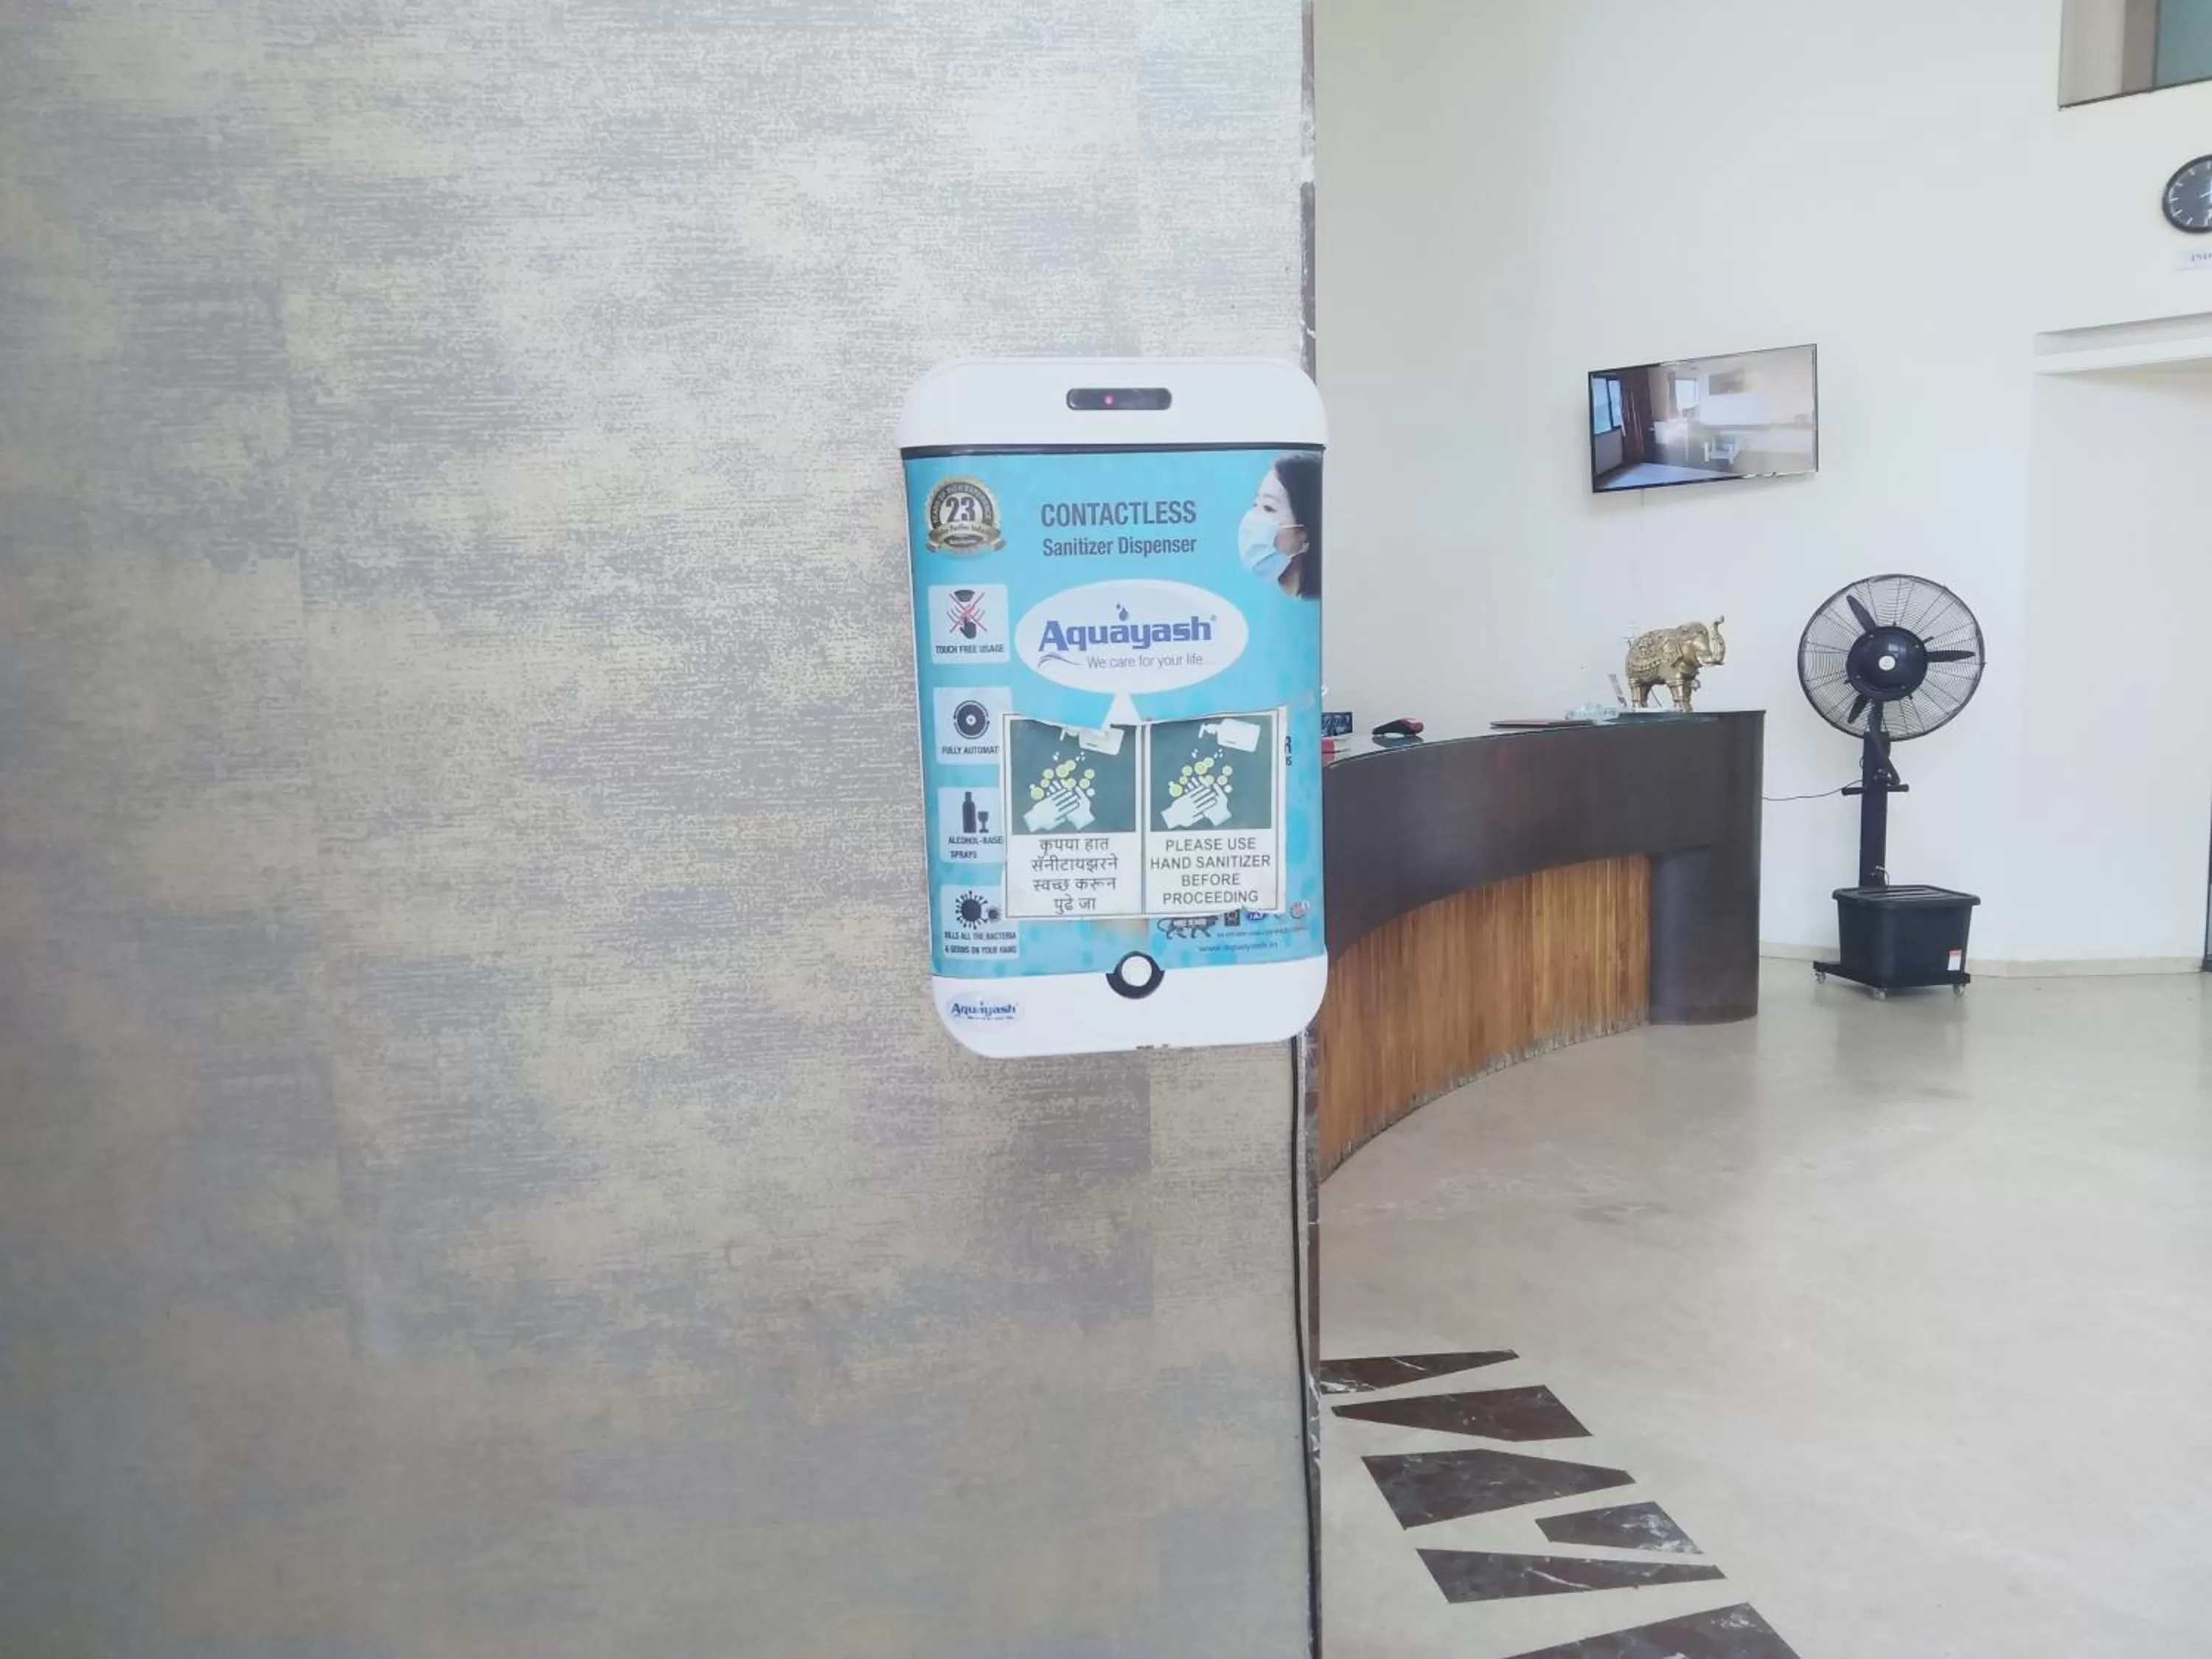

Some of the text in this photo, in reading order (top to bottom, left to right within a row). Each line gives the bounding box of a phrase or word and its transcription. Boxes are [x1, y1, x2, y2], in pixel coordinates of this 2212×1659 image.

[946, 496, 975, 523] 23
[1041, 500, 1197, 526] CONTACTLESS
[1043, 536, 1197, 557] Sanitizer Dispenser
[1038, 616, 1211, 652] Aquayash
[936, 644, 957, 654] TOUCH
[959, 644, 978, 653] FREE
[1087, 652, 1203, 669] We care for your life
[942, 745, 999, 754] FULLY AUTOMAT
[948, 835, 1004, 844] ALCOHOL-BASE
[1038, 838, 1110, 855] कृपया हात
[1166, 837, 1256, 851] PLEASE USE
[950, 850, 977, 859] SPRAYS
[1150, 855, 1270, 870] HAND SANITIZER
[1032, 878, 1071, 891] स्वच्छ
[1181, 873, 1241, 887] BEFORE
[1054, 894, 1096, 914] पुढे जा
[1163, 890, 1259, 905] PROCEEDING
[987, 931, 1016, 940] BACTERIA
